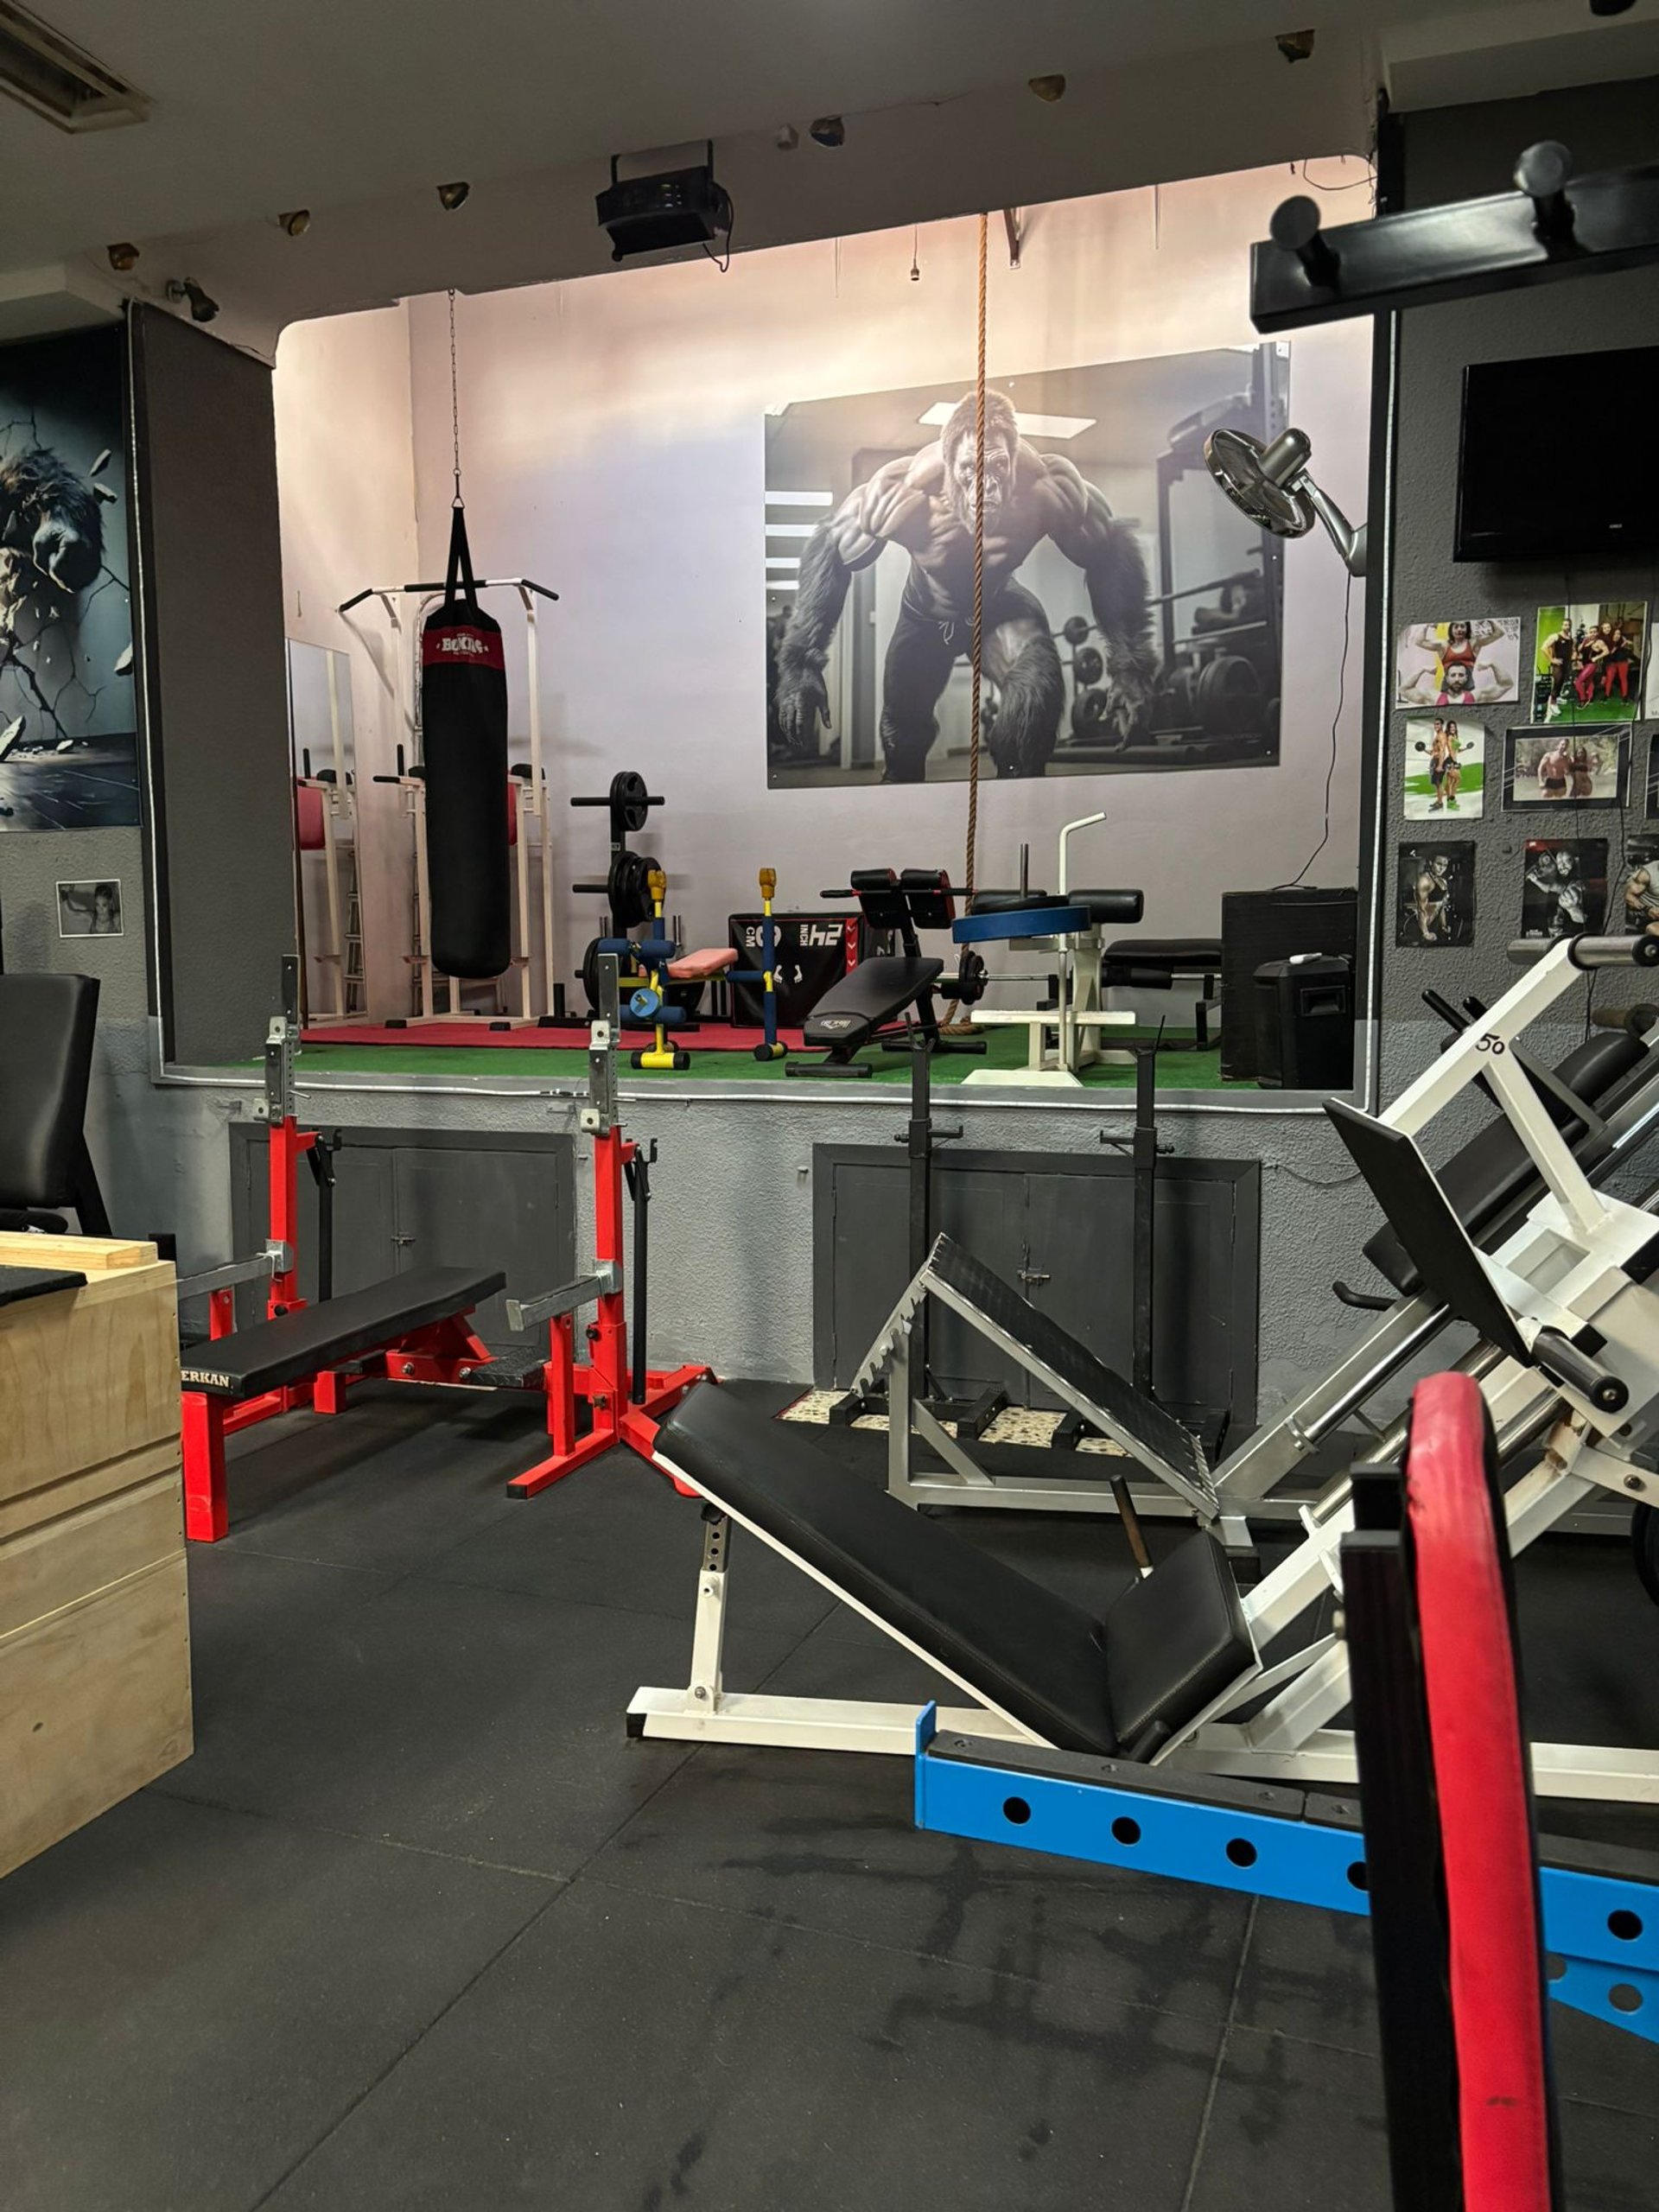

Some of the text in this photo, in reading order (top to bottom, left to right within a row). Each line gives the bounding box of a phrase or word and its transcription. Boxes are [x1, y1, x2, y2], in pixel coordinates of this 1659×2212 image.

[746, 926, 756, 947] CM
[799, 924, 843, 946] 24 INCH
[1475, 1033, 1506, 1055] 50
